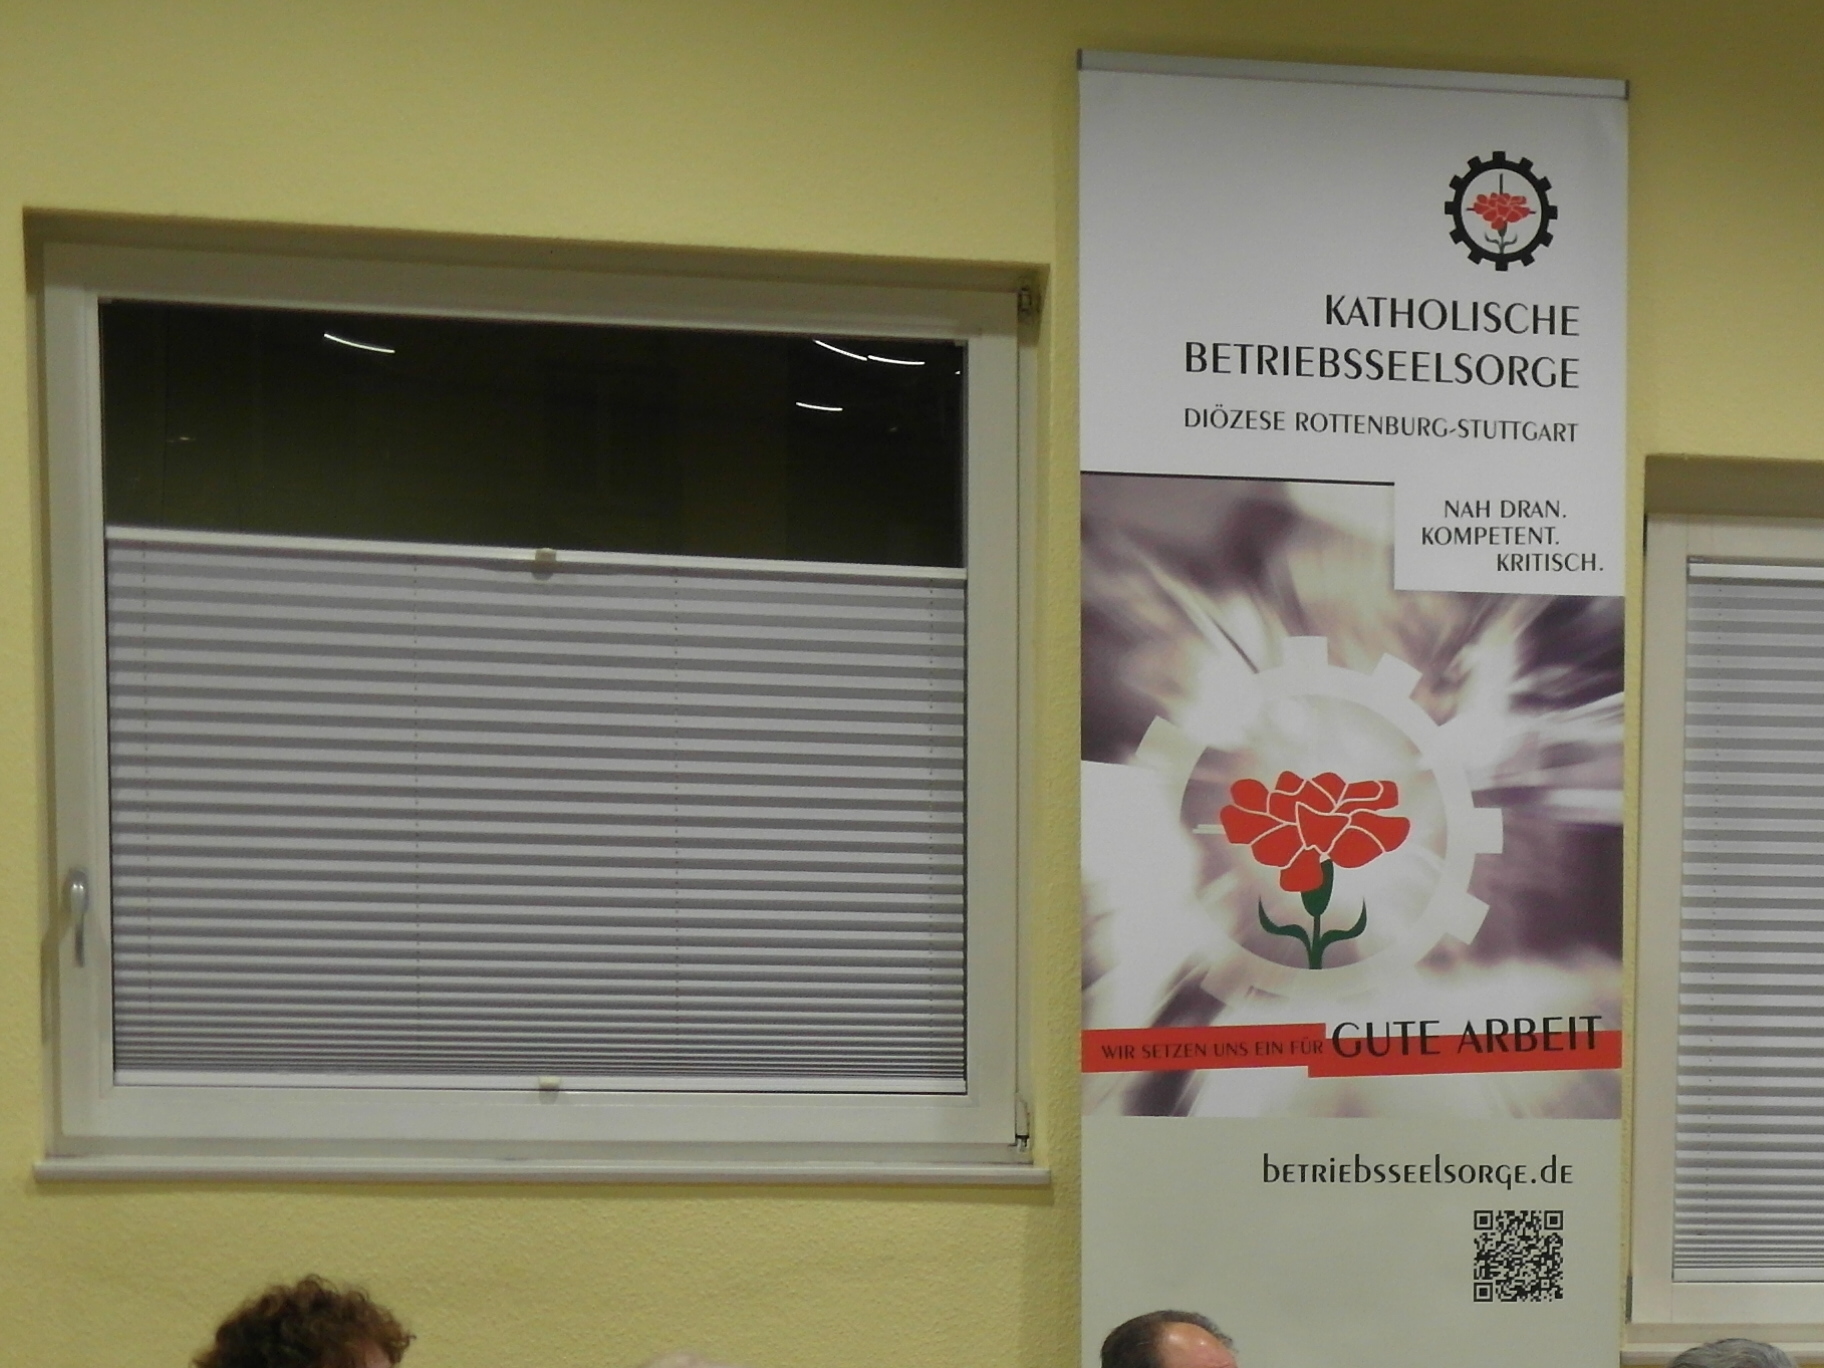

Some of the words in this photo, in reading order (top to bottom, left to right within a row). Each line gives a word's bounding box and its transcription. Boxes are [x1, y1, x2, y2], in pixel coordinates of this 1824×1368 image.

[1324, 294, 1580, 336] KATHOLISCHE
[1184, 341, 1580, 389] BETRIEBSSEELSORGE
[1184, 403, 1286, 431] DIÖZESE
[1295, 412, 1579, 443] ROTTENBURG-STUTTGART
[1443, 499, 1491, 518] NAH
[1499, 499, 1567, 519] DRAN.
[1421, 526, 1560, 546] KOMPETENT.
[1496, 552, 1604, 572] KRITISCH.
[1101, 1043, 1135, 1061] WIR
[1142, 1040, 1207, 1060] SETZEN
[1213, 1039, 1248, 1058] UNS
[1255, 1039, 1284, 1056] EIN
[1290, 1035, 1324, 1055] FÜR
[1331, 1020, 1441, 1059] GUTE
[1457, 1015, 1602, 1055] ARBEIT
